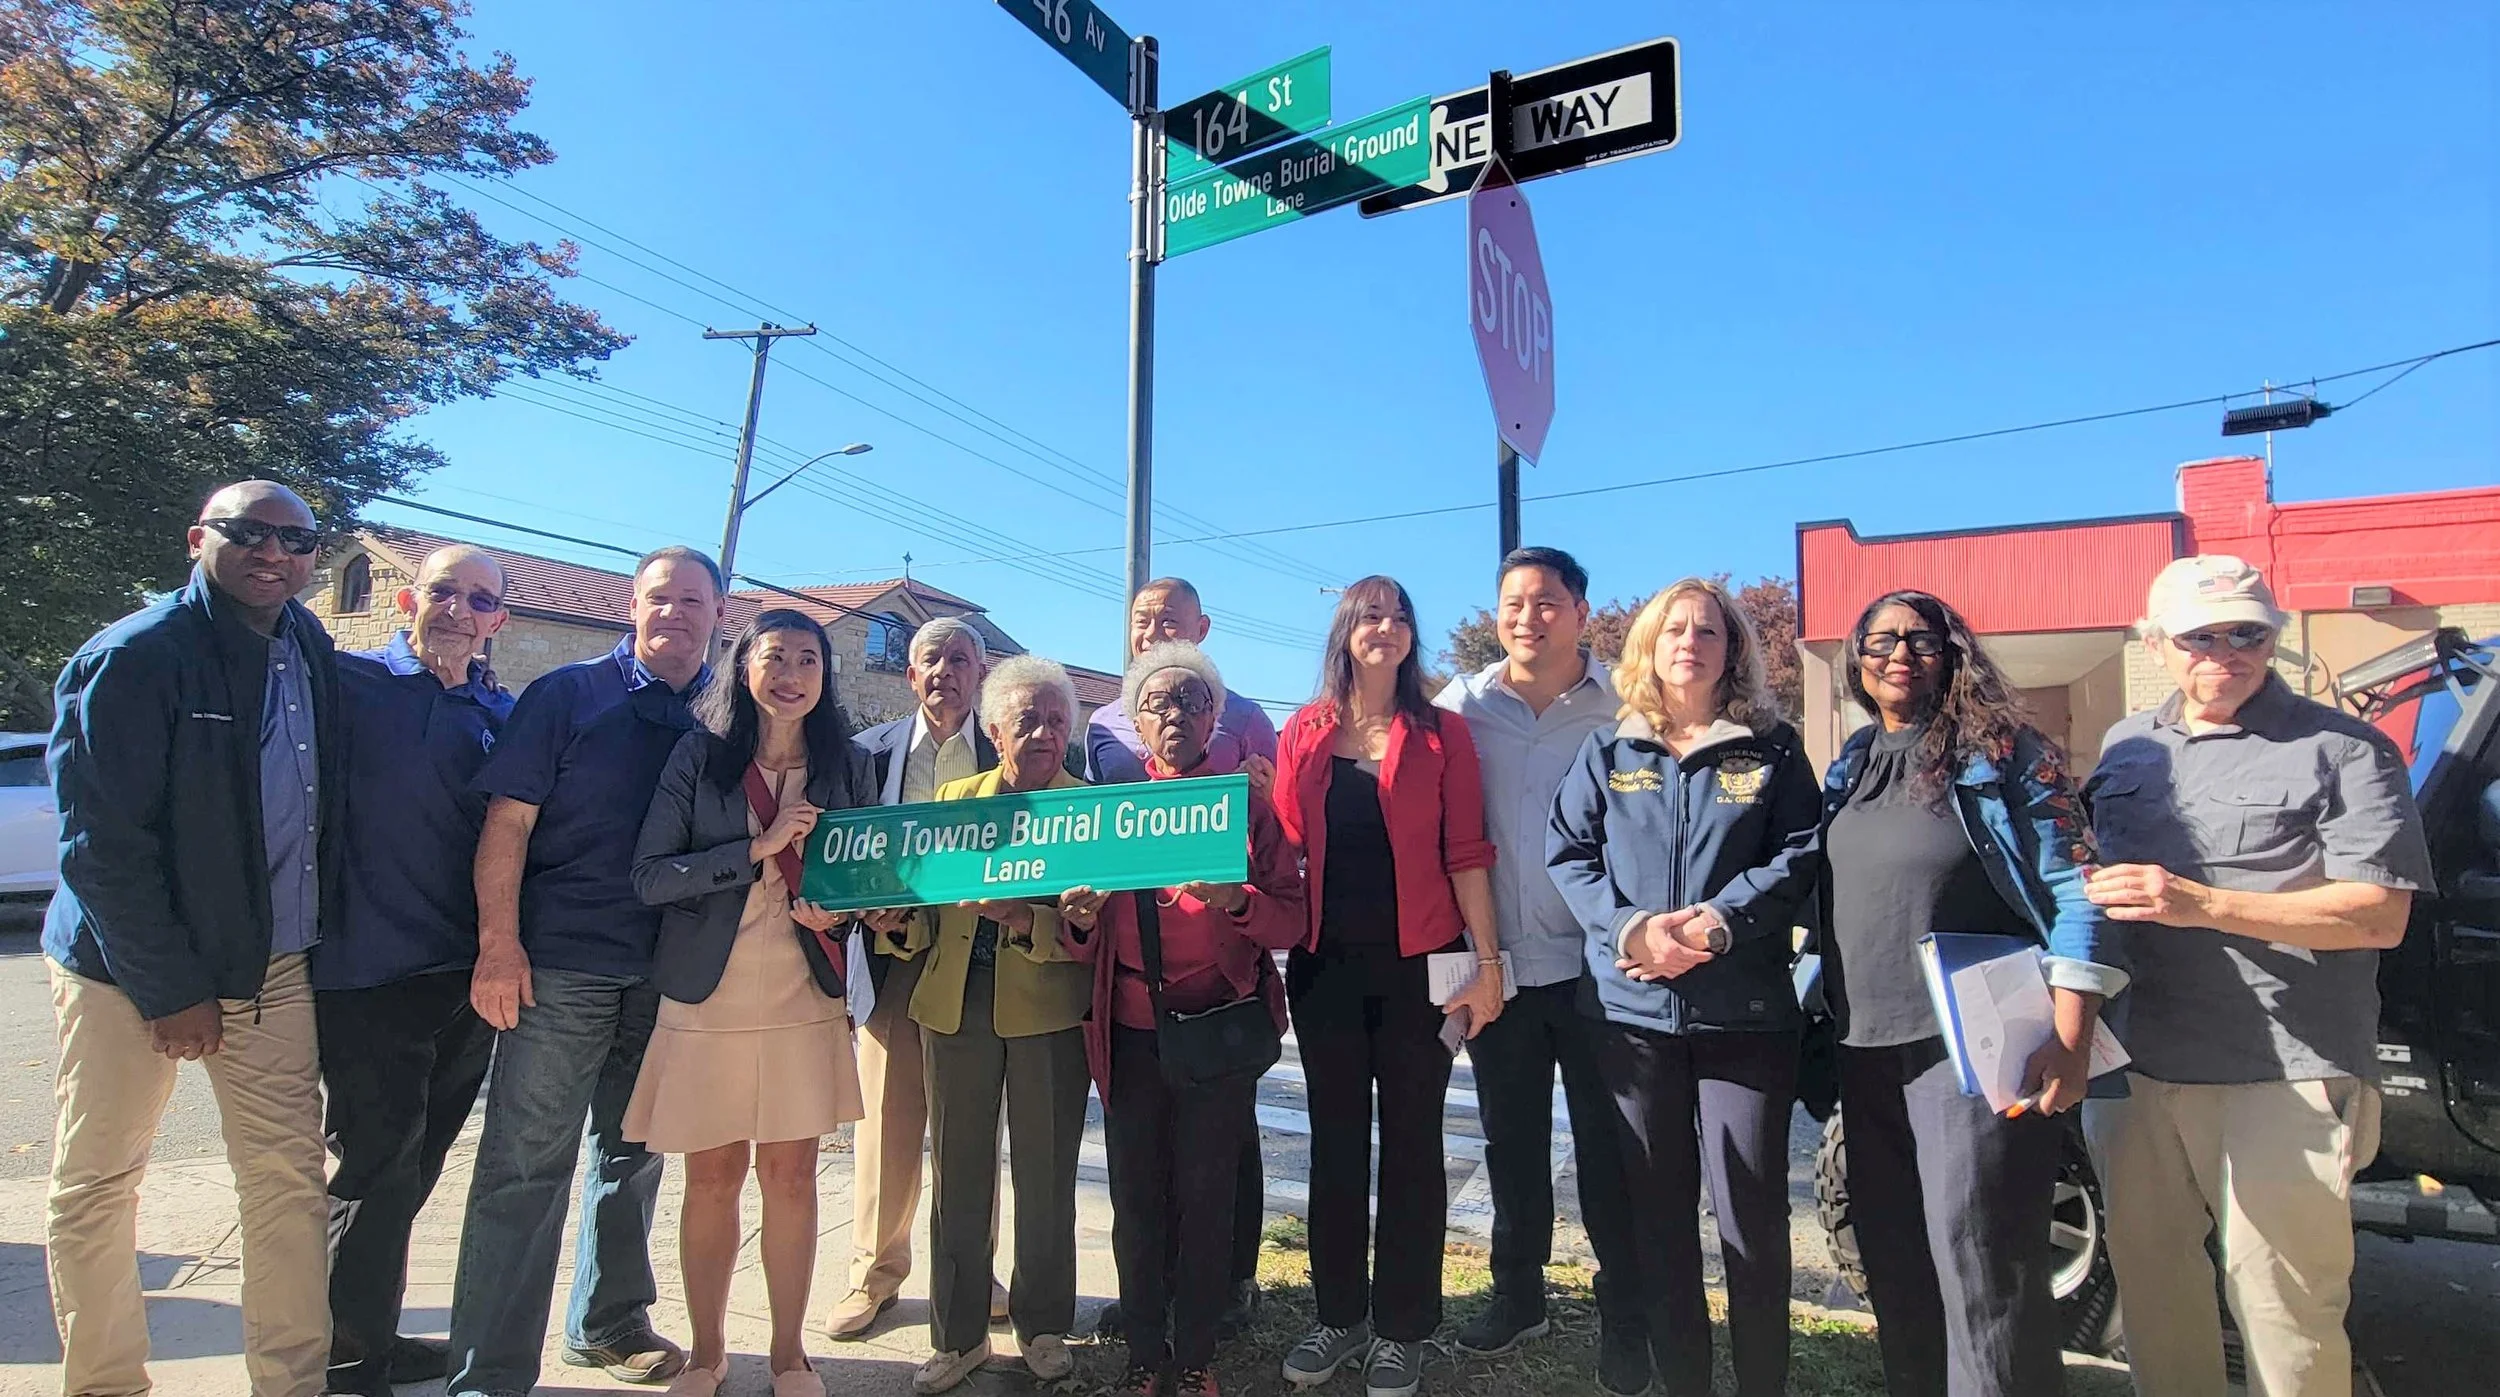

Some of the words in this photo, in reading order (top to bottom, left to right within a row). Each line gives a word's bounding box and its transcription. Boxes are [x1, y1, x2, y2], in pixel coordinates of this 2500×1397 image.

[1033, 0, 1071, 43] 46
[1194, 90, 1249, 161] 164
[1268, 73, 1292, 112] St
[1436, 120, 1487, 167] NE
[1531, 85, 1621, 143] WAY
[1169, 189, 1207, 222] Olde
[1213, 172, 1273, 208] Towne
[1281, 142, 1336, 187] Burial
[1344, 114, 1419, 165] Ground
[1267, 192, 1305, 217] Lane
[1477, 227, 1549, 384] STOP
[823, 825, 888, 864] Olde
[901, 820, 998, 857] Towne
[1010, 803, 1101, 847] Burial
[1115, 793, 1229, 839] Ground
[983, 857, 1046, 883] Lane
